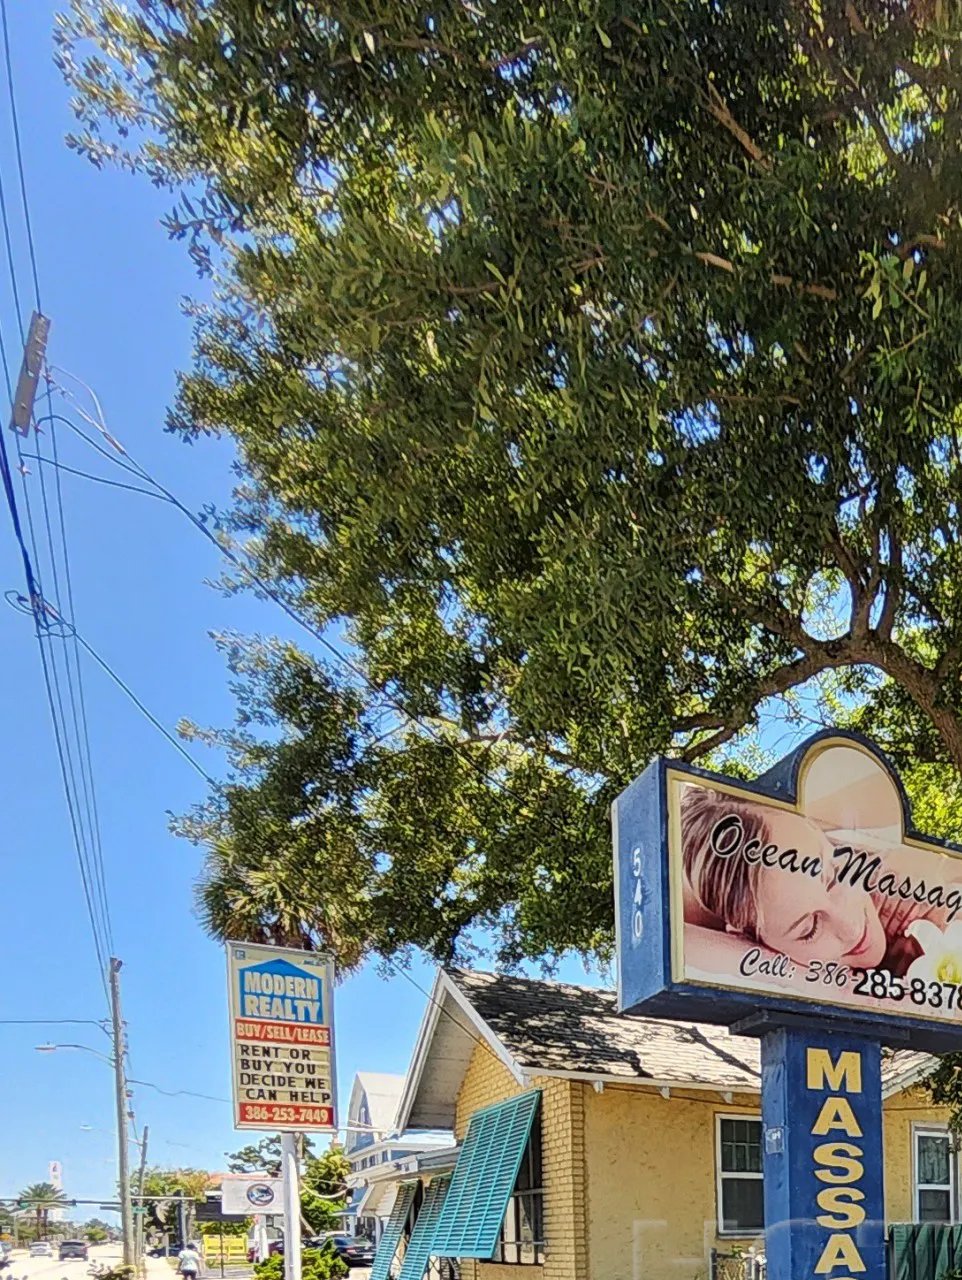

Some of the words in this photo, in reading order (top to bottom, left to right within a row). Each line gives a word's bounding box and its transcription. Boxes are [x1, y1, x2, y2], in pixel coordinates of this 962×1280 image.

[711, 816, 823, 876] Ocean
[632, 847, 643, 939] 540
[739, 948, 795, 979] Call:
[244, 971, 319, 1000] MODERN
[244, 994, 321, 1022] REALTY
[236, 1022, 330, 1043] BUY/SELL/LEASE
[240, 1044, 281, 1059] RENT
[289, 1048, 311, 1061] OR
[240, 1059, 275, 1071] BUY
[283, 1061, 316, 1075] YOU
[240, 1073, 296, 1088] DECIDE
[304, 1077, 326, 1090] WE
[245, 1087, 278, 1101] CAN
[289, 1089, 331, 1104] HELP
[245, 1105, 329, 1123] 386-253-7449
